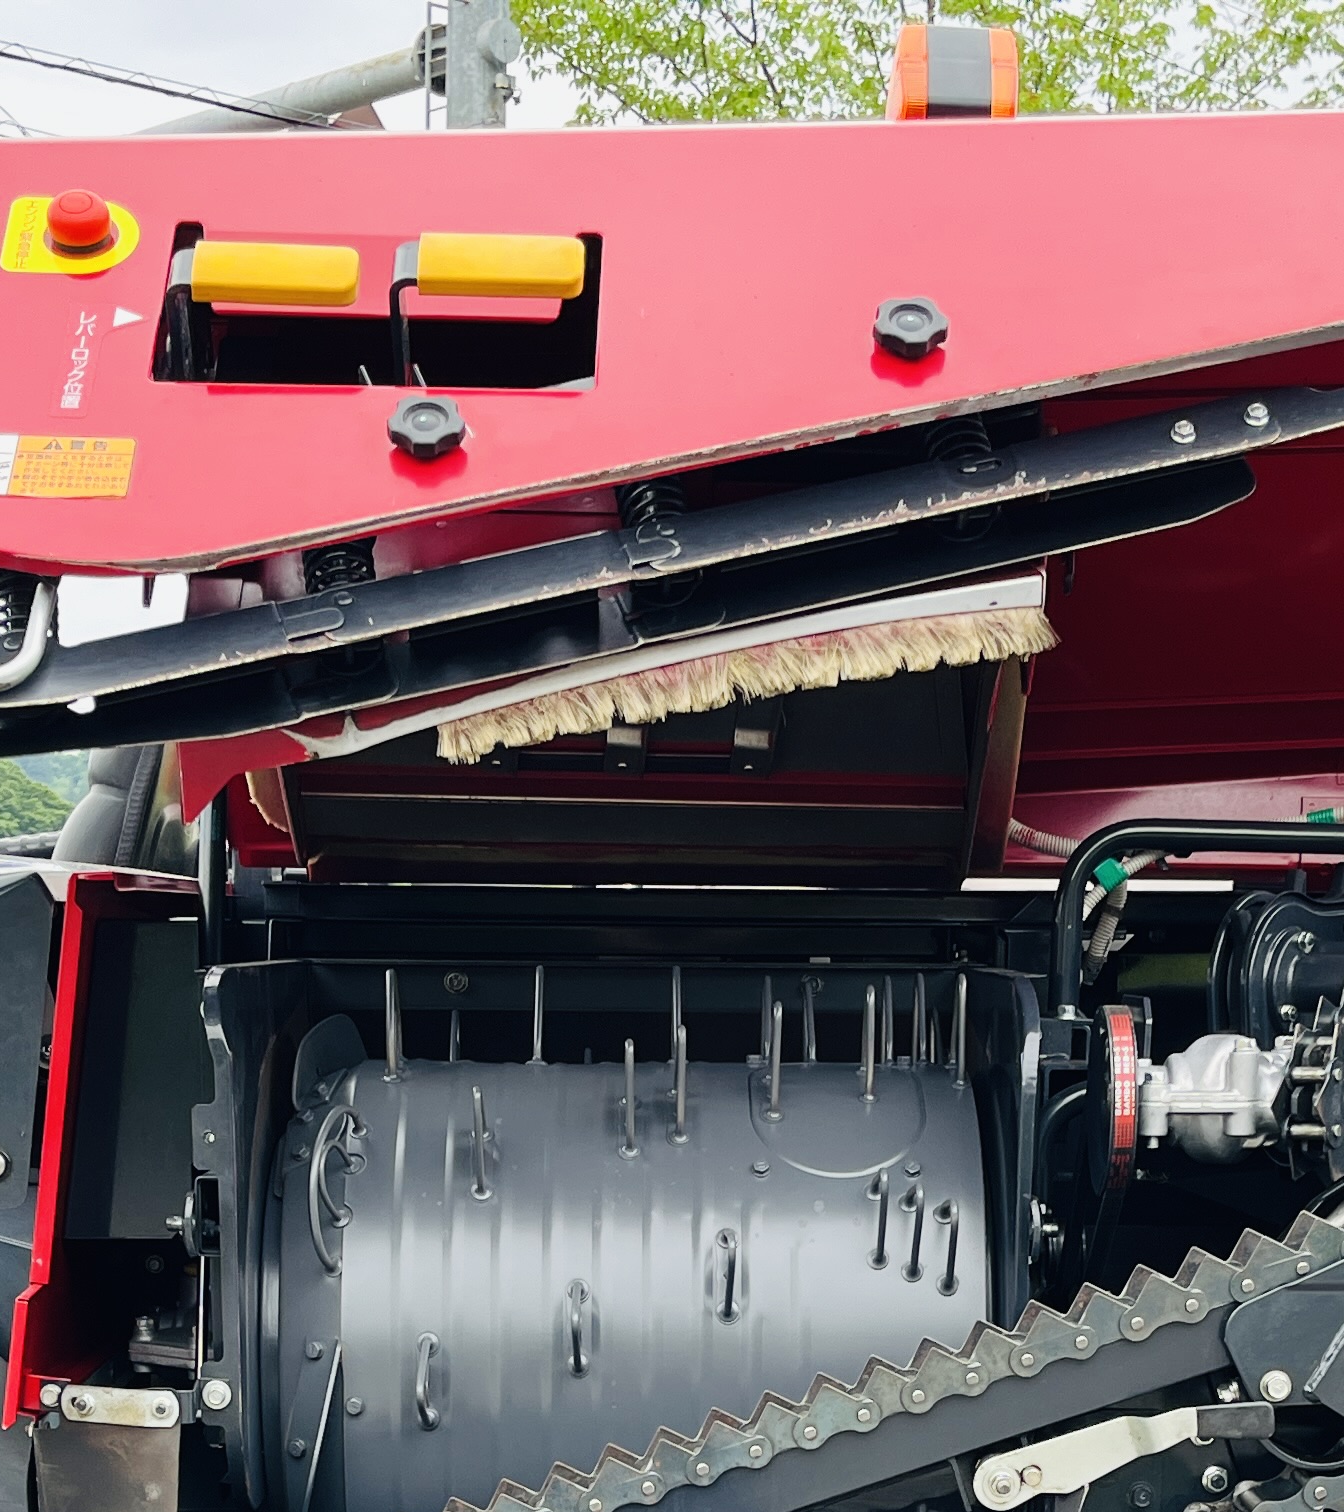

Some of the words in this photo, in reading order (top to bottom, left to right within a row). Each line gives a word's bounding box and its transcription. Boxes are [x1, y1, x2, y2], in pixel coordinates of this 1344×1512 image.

[60, 310, 97, 409] レバーロック位置
